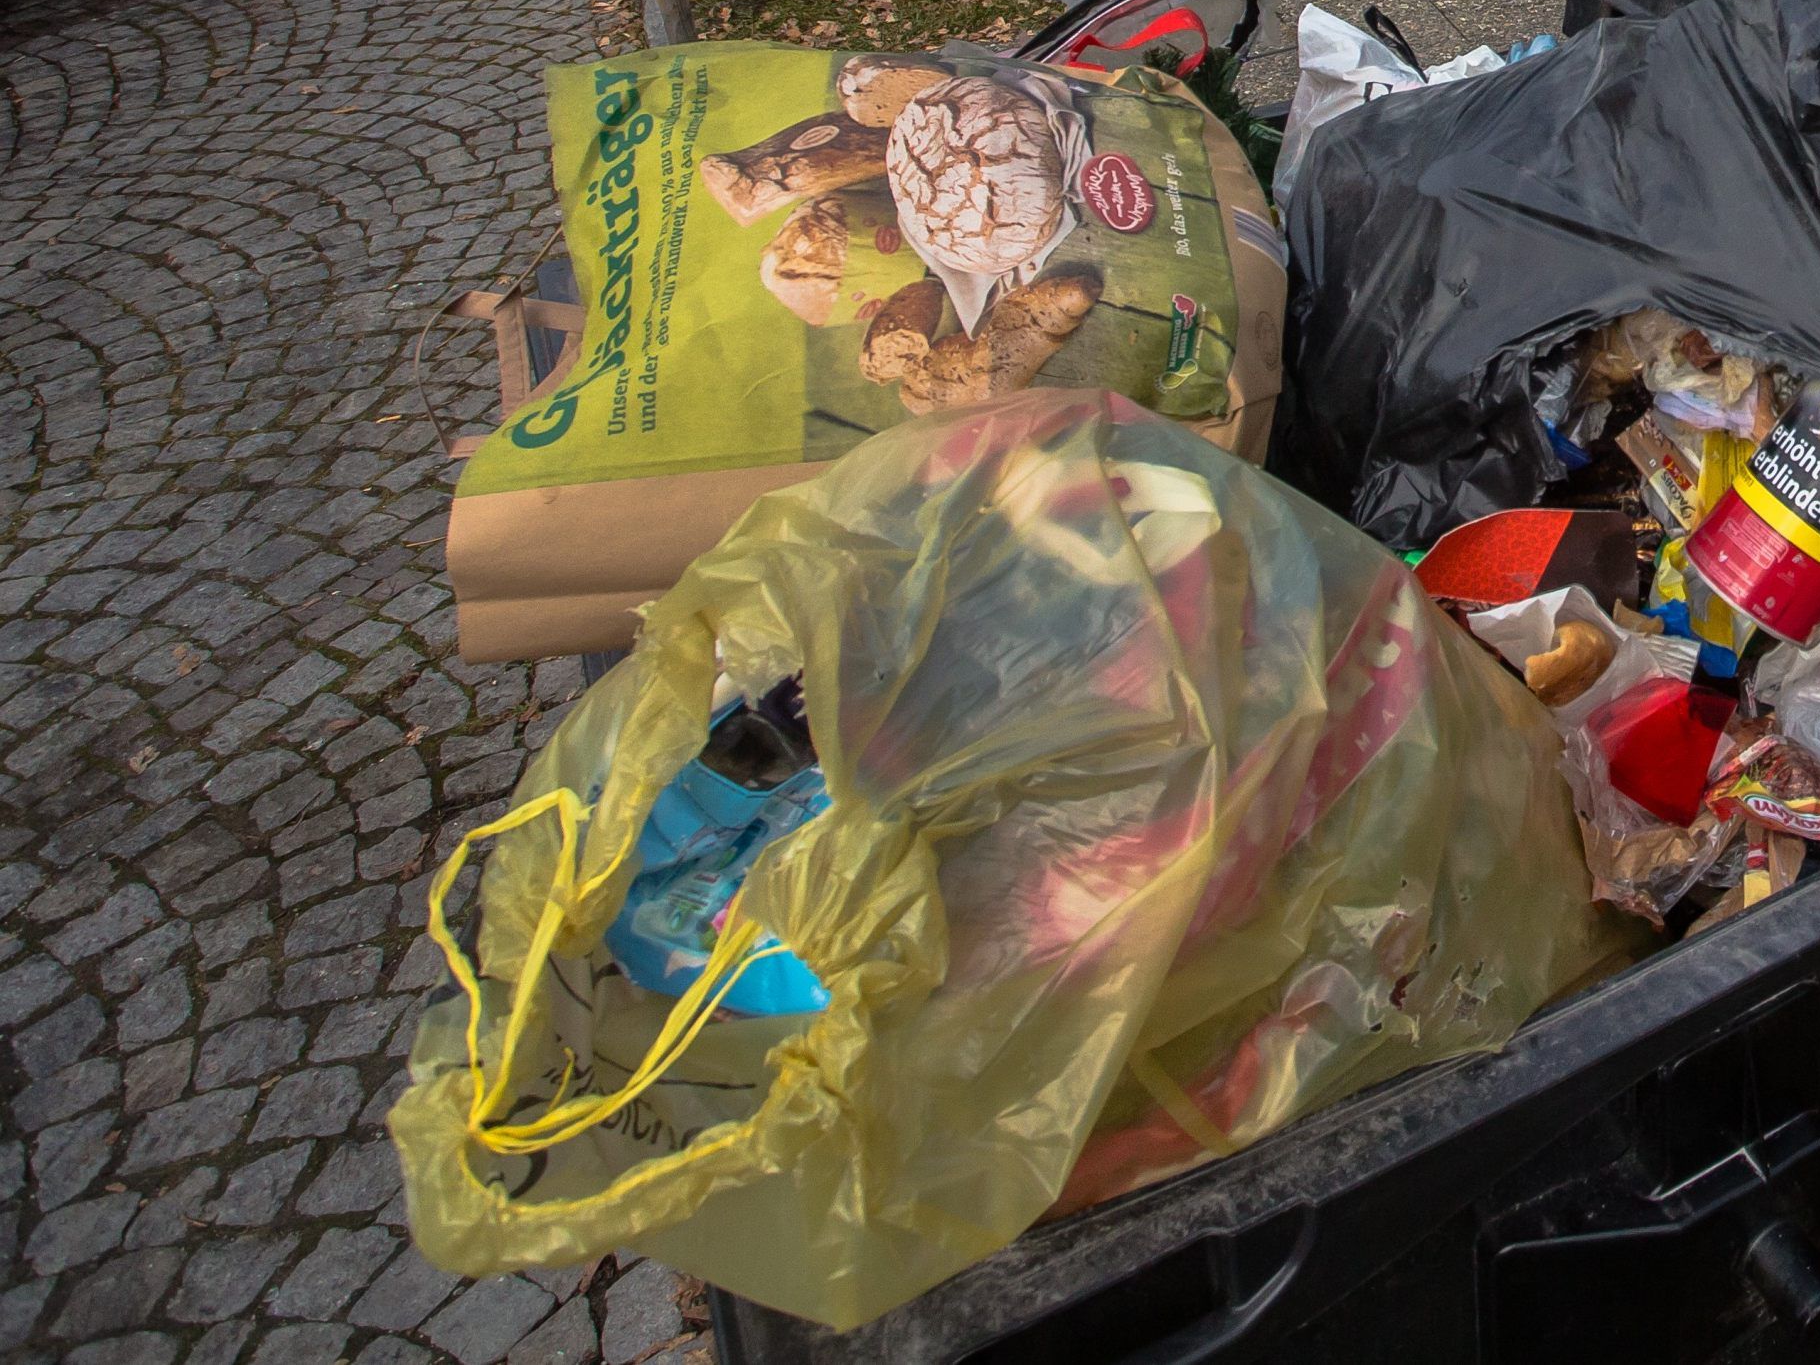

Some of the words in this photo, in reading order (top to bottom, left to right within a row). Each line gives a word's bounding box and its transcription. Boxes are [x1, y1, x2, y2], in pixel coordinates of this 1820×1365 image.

[679, 141, 693, 169] das
[1126, 173, 1155, 222] Ursprung
[1165, 177, 1184, 211] weiter
[664, 200, 689, 278] Handwerk.
[1170, 213, 1187, 236] das
[607, 367, 632, 436] Unsere
[660, 149, 674, 177] aus
[660, 280, 677, 315] zum
[638, 354, 659, 387] der
[637, 389, 657, 434] und
[1661, 470, 1697, 519] JACOBS
